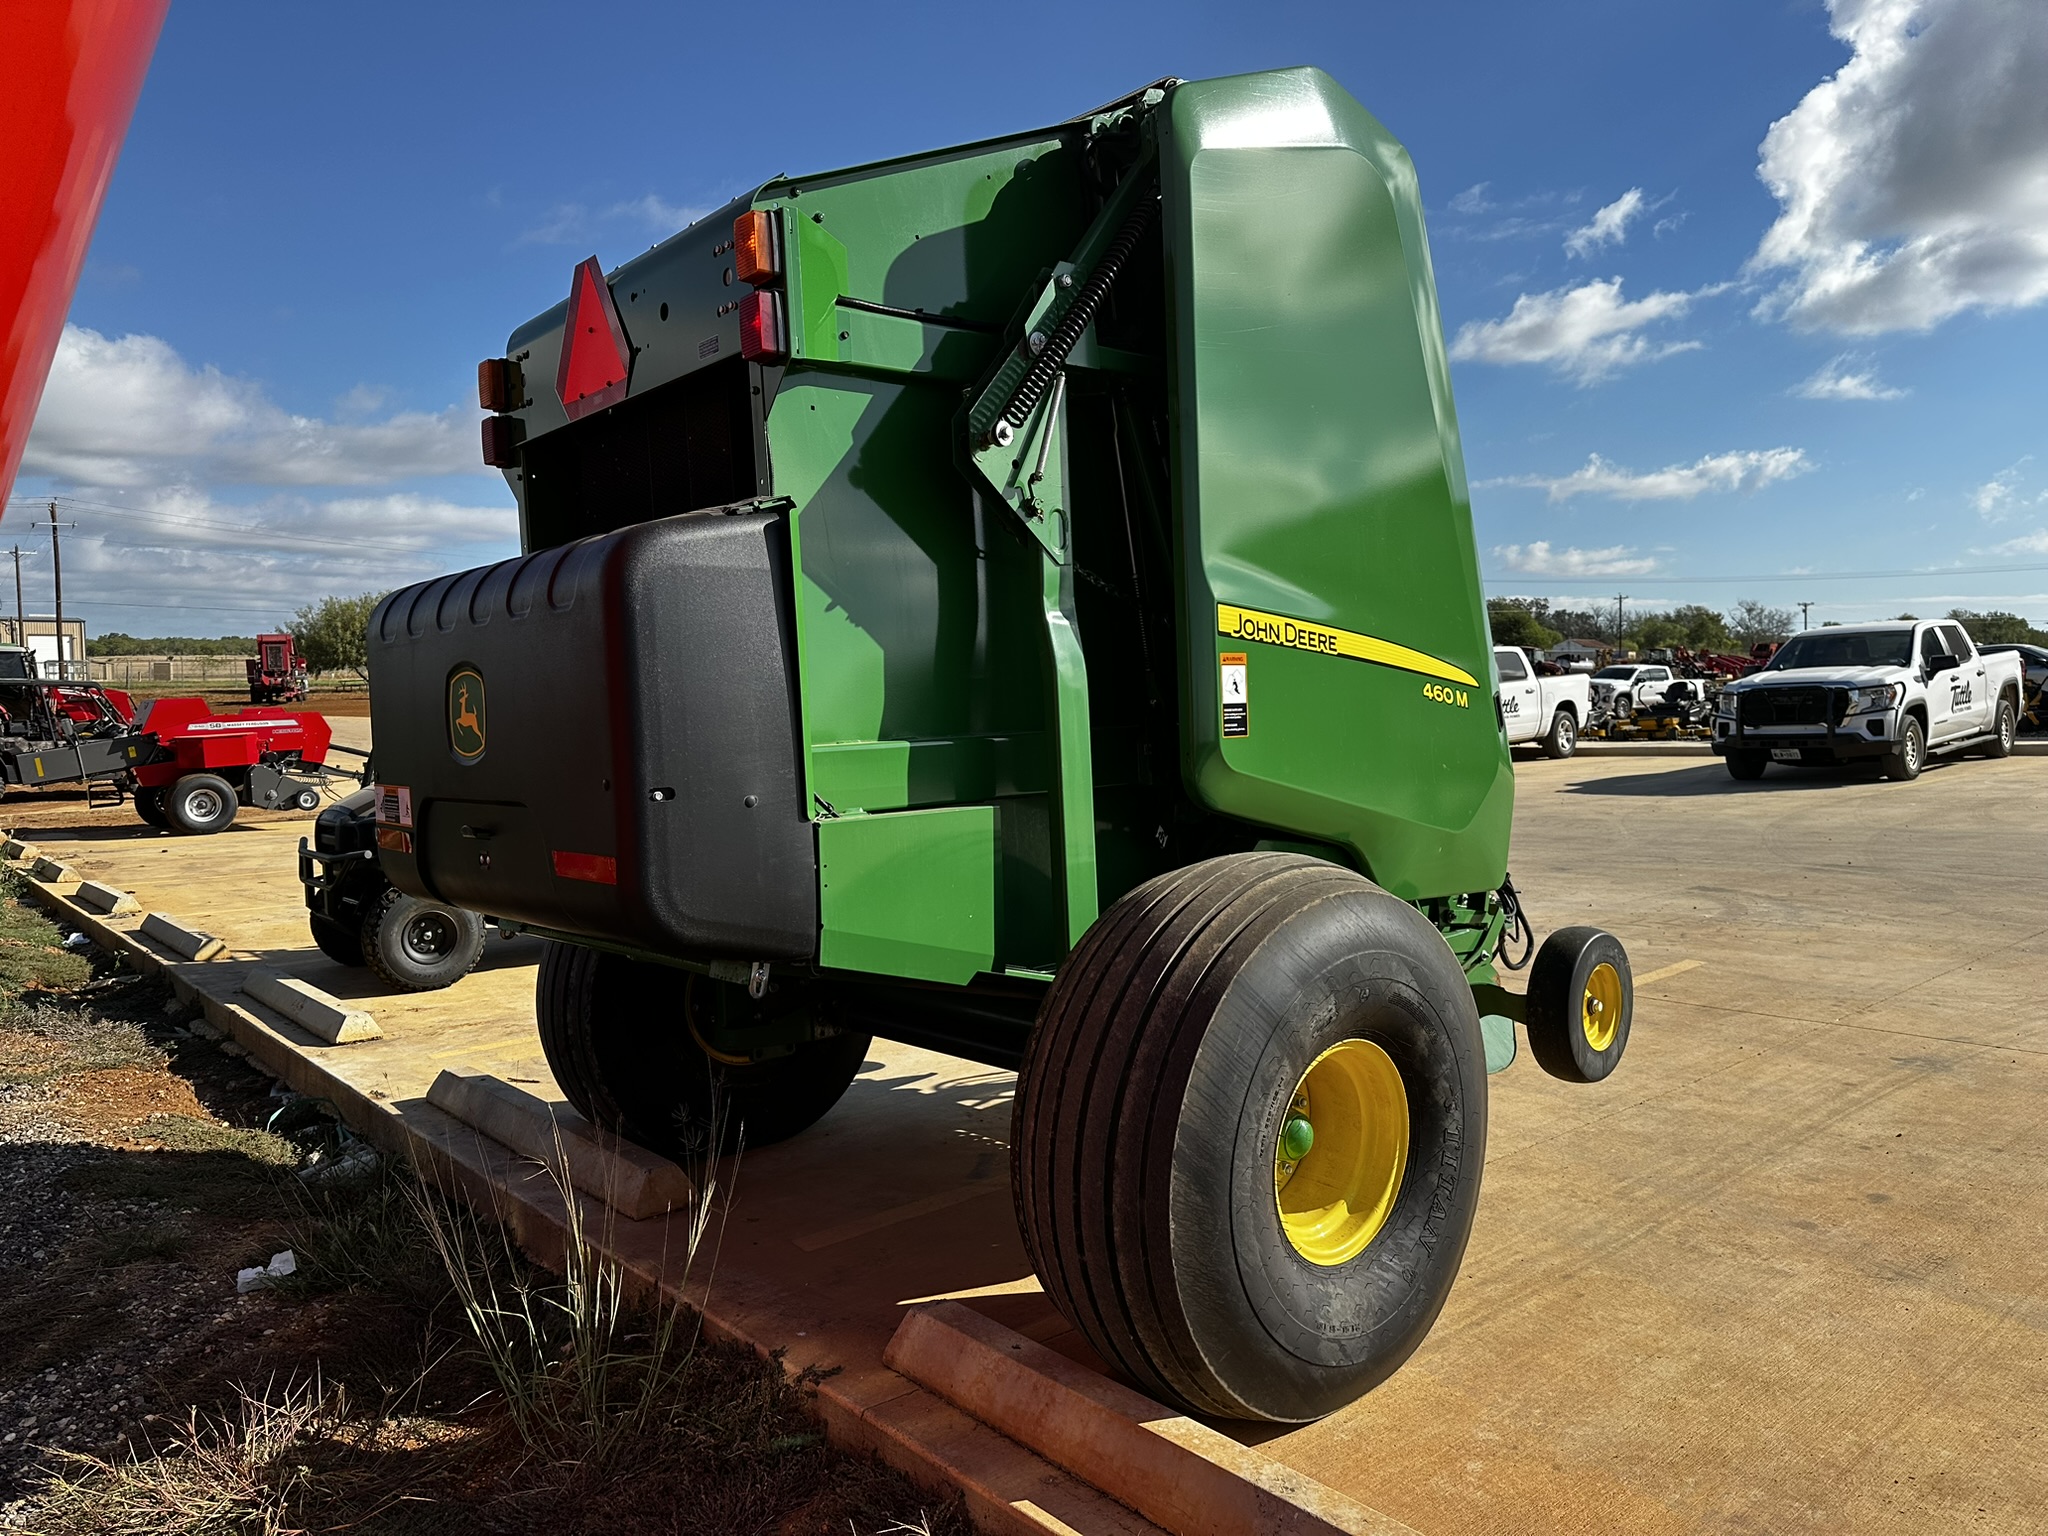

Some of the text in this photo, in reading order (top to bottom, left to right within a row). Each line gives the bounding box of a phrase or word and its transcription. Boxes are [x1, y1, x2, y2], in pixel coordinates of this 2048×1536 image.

[1233, 613, 1338, 652] JOHN DEERE
[1422, 682, 1469, 708] 460 M
[1950, 680, 1972, 714] Tuttle
[1417, 1125, 1463, 1258] TITAN
